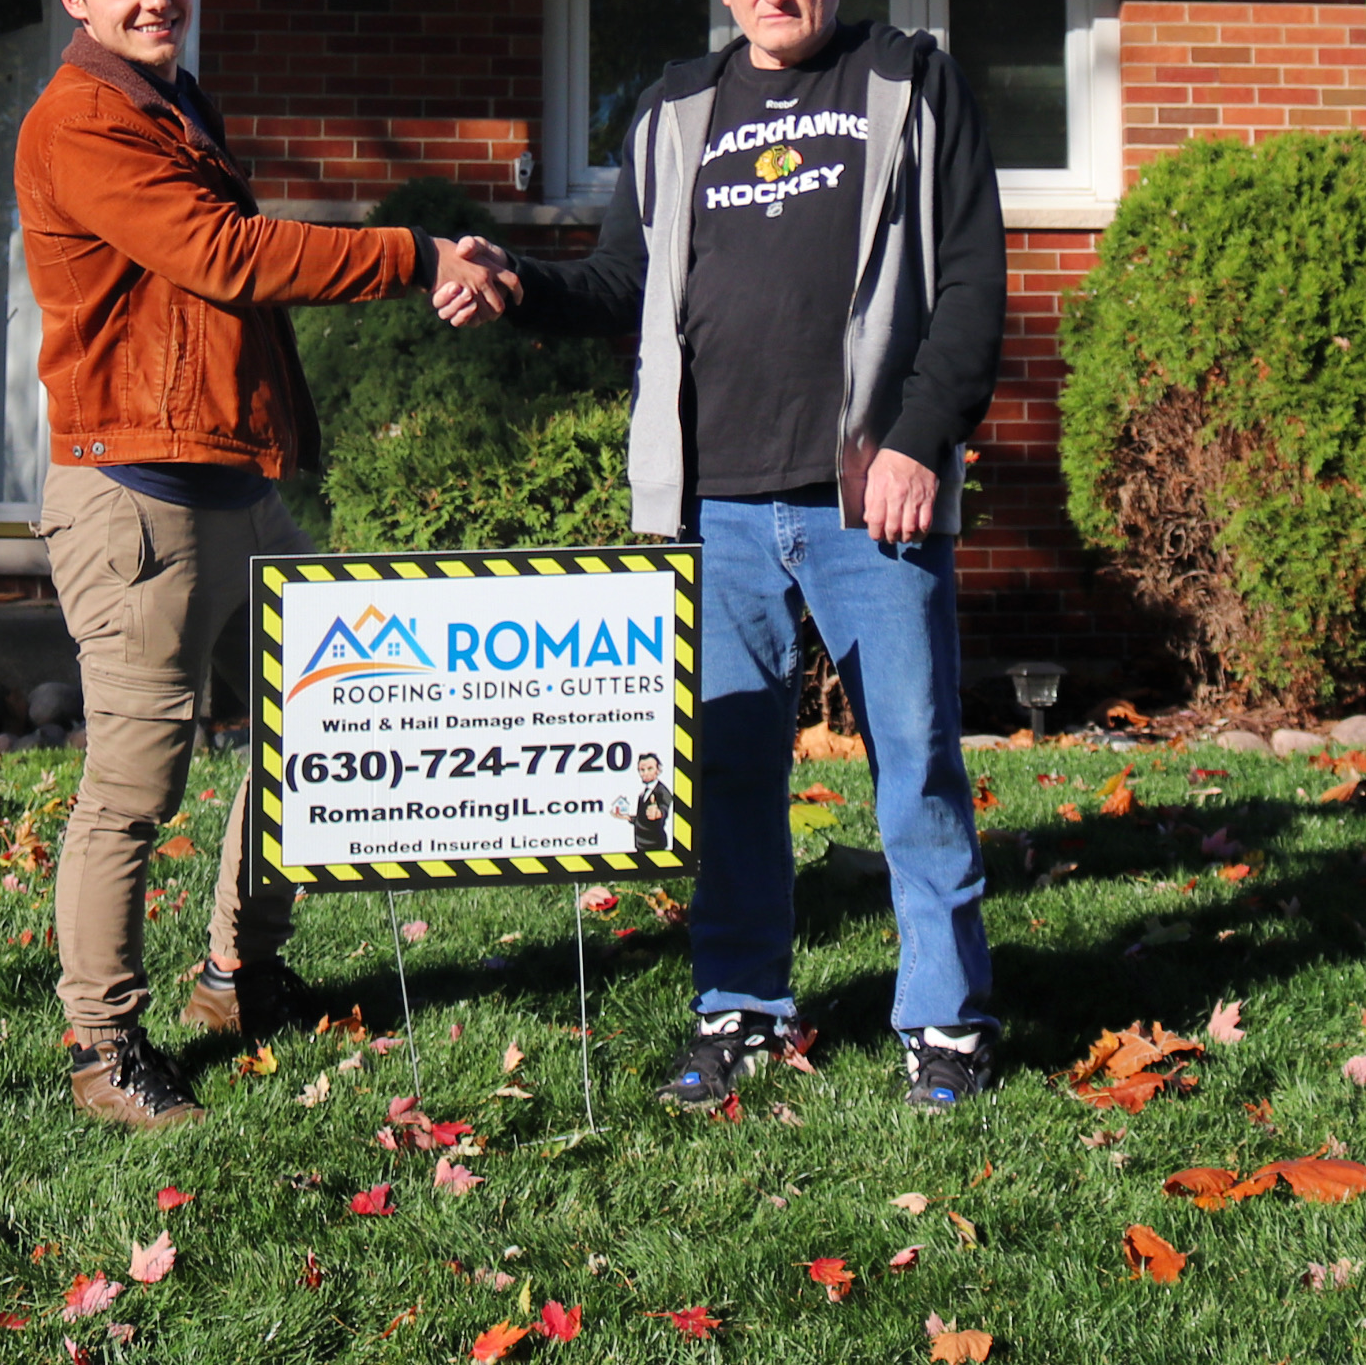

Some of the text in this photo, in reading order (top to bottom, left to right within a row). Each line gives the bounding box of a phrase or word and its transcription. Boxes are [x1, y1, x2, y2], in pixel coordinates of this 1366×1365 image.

[701, 111, 868, 167] LACKHAWKS
[706, 164, 845, 210] HOCKEY
[447, 615, 664, 673] ROMAN
[333, 675, 664, 705] ROOFING SIDING GUTTERS
[322, 709, 655, 732] Wind & Hail Damage Restorations
[285, 741, 632, 792] (630)-724-7720
[309, 798, 604, 824] RomanRoofingIL.com
[350, 833, 598, 855] Bonded Insured Licenced
